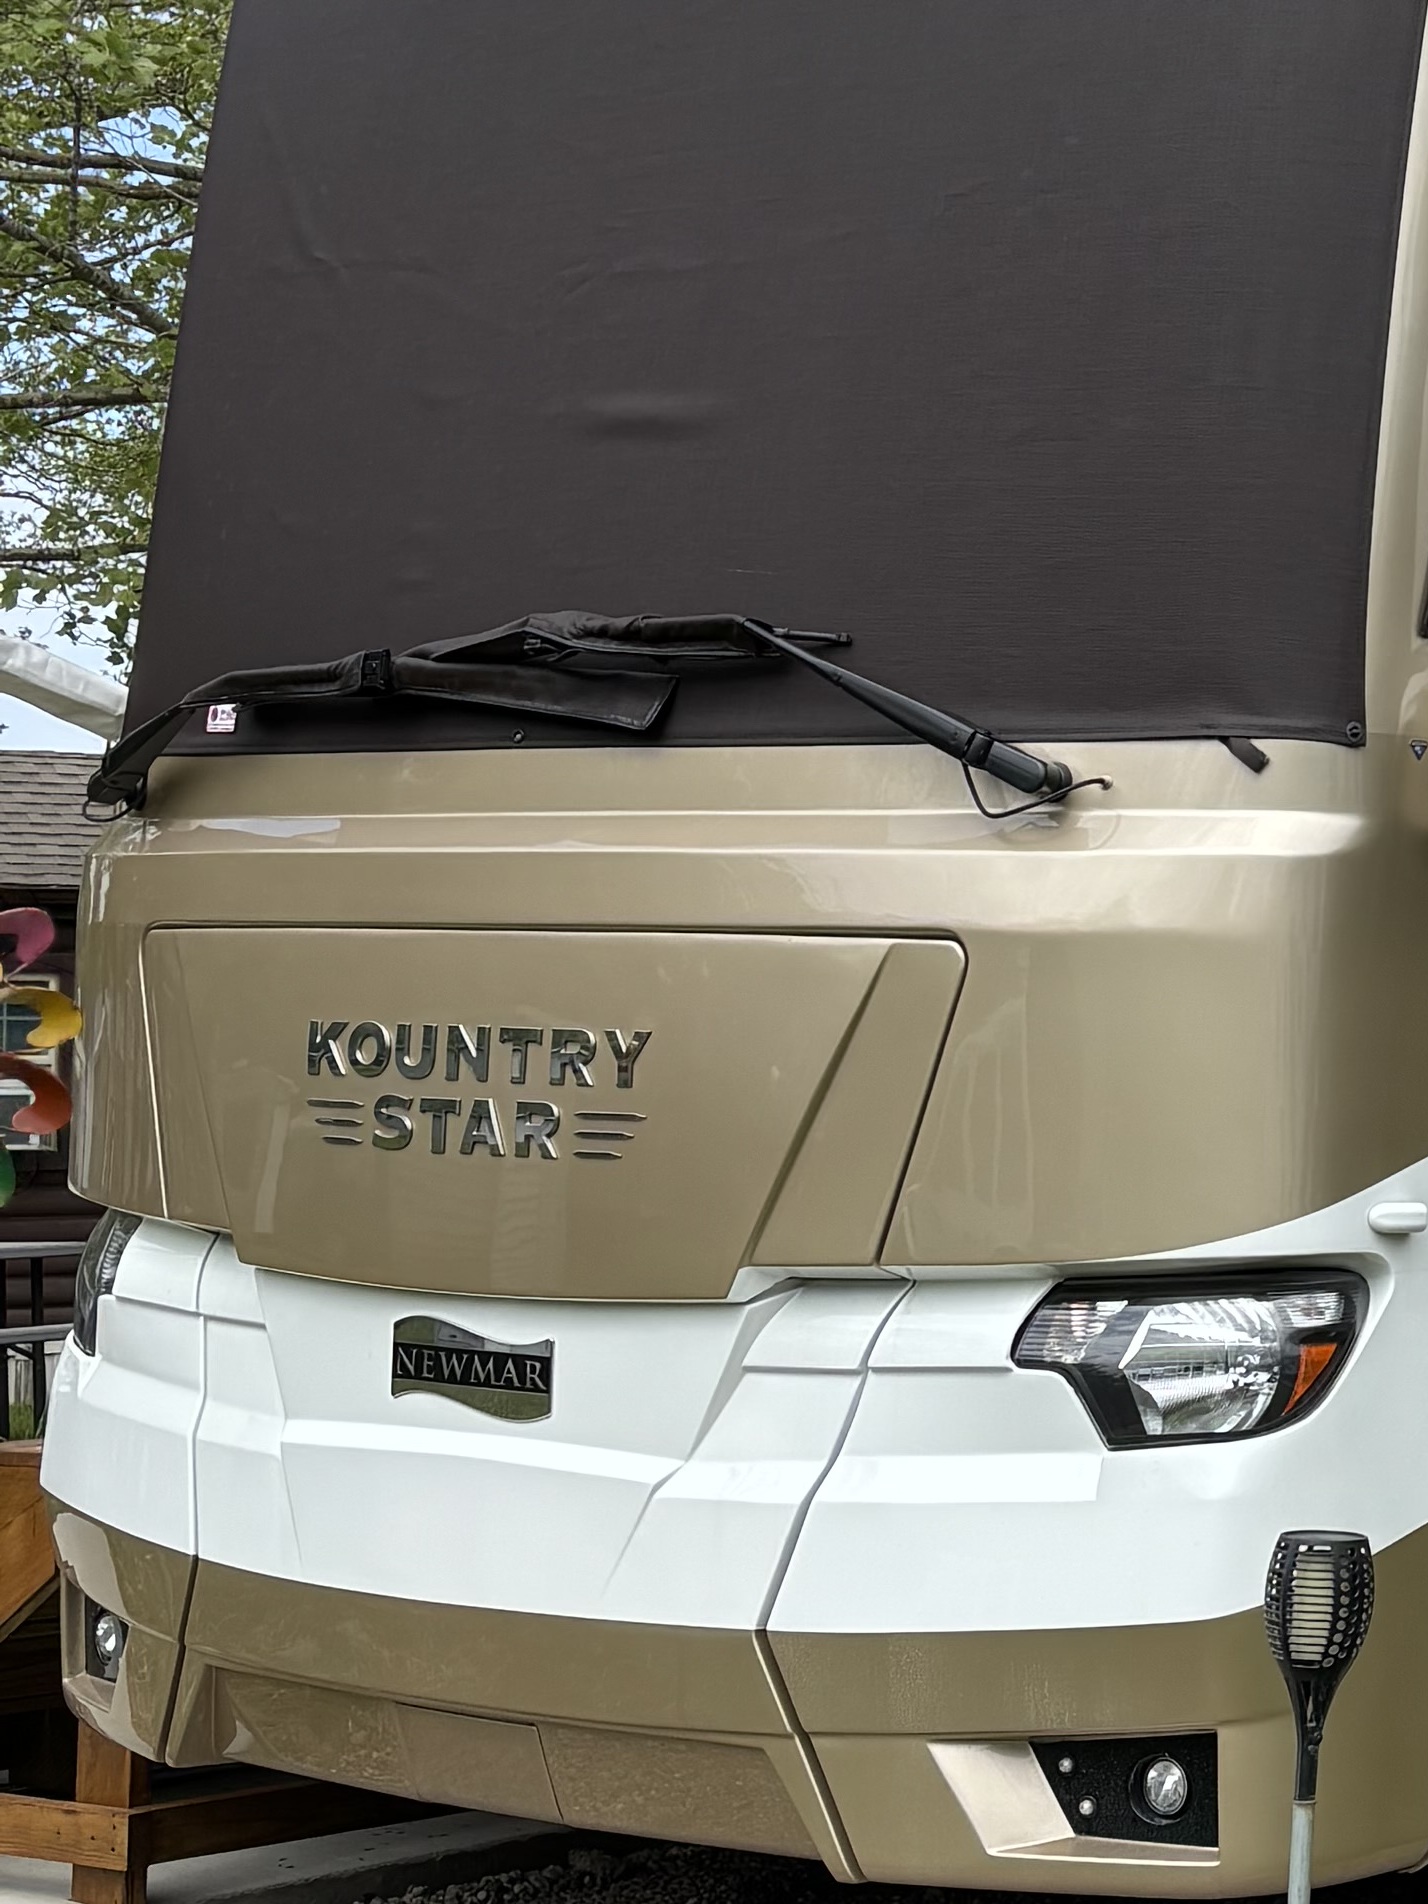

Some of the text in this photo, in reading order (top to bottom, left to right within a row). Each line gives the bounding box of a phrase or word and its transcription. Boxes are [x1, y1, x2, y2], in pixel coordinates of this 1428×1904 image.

[306, 1019, 653, 1089] KOUNTRY
[371, 1093, 561, 1160] STAR
[396, 1347, 547, 1391] NEWMAR
